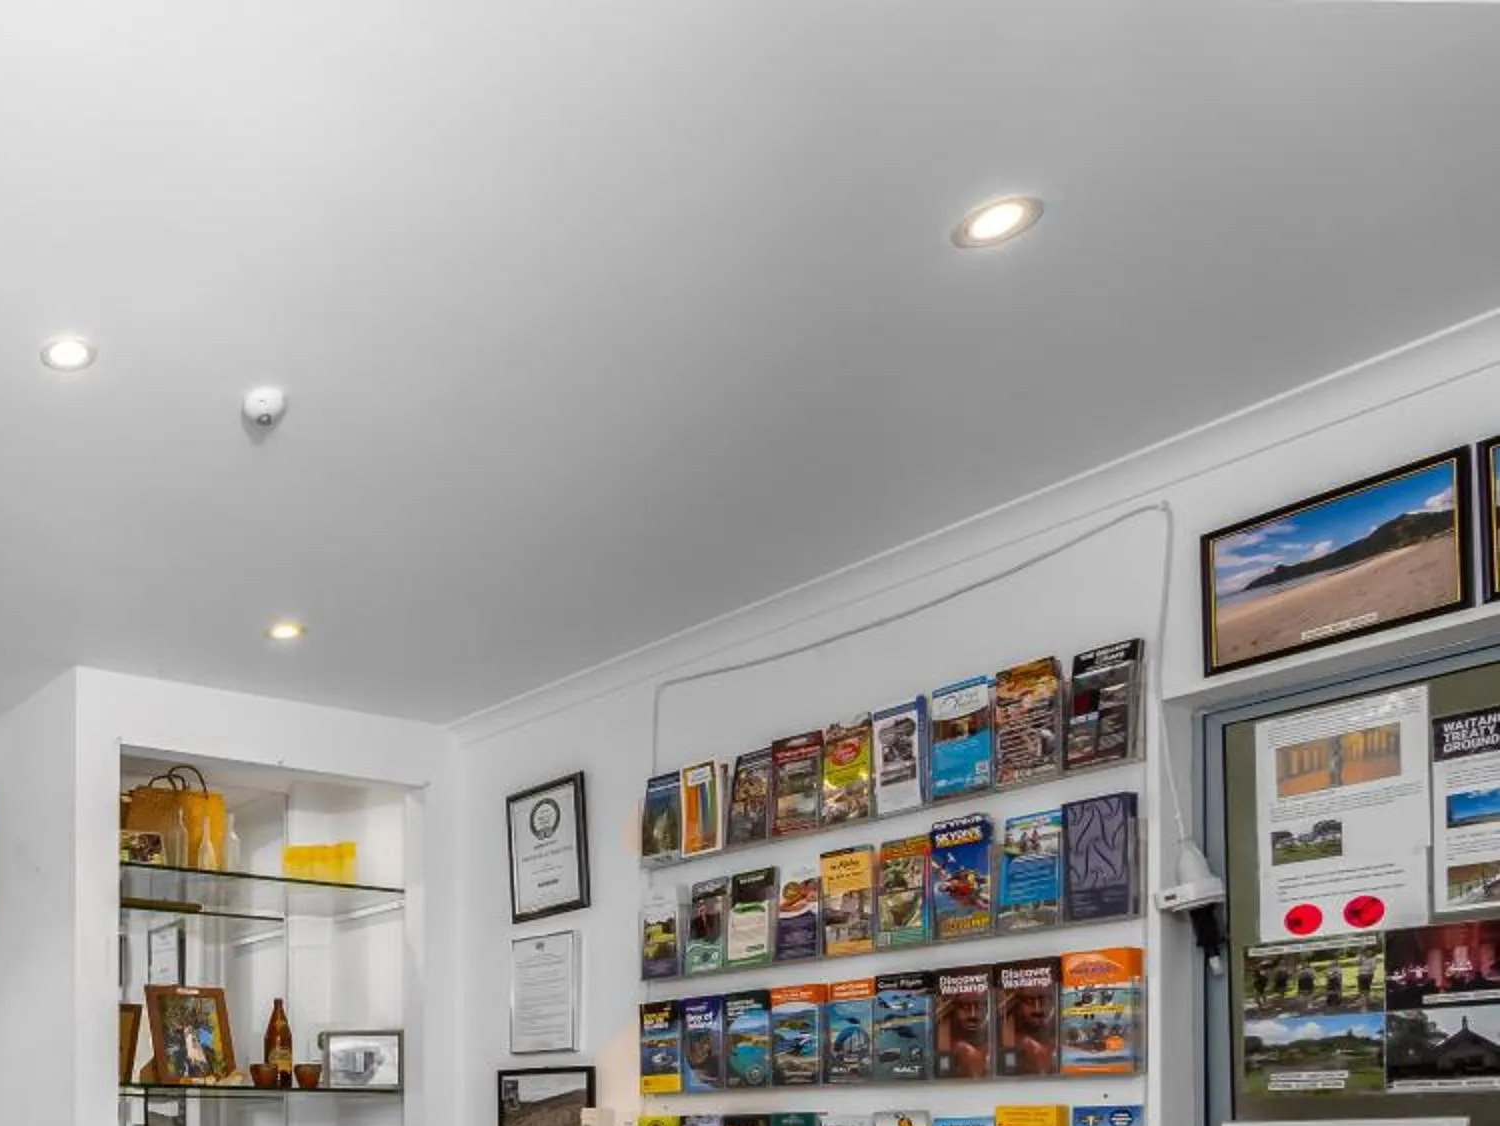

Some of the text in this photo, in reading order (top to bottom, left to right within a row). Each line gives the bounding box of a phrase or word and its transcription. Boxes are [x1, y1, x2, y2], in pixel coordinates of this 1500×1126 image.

[1443, 713, 1500, 732] WAITAN
[1443, 726, 1496, 743] TREATY
[1001, 967, 1051, 980] Discover
